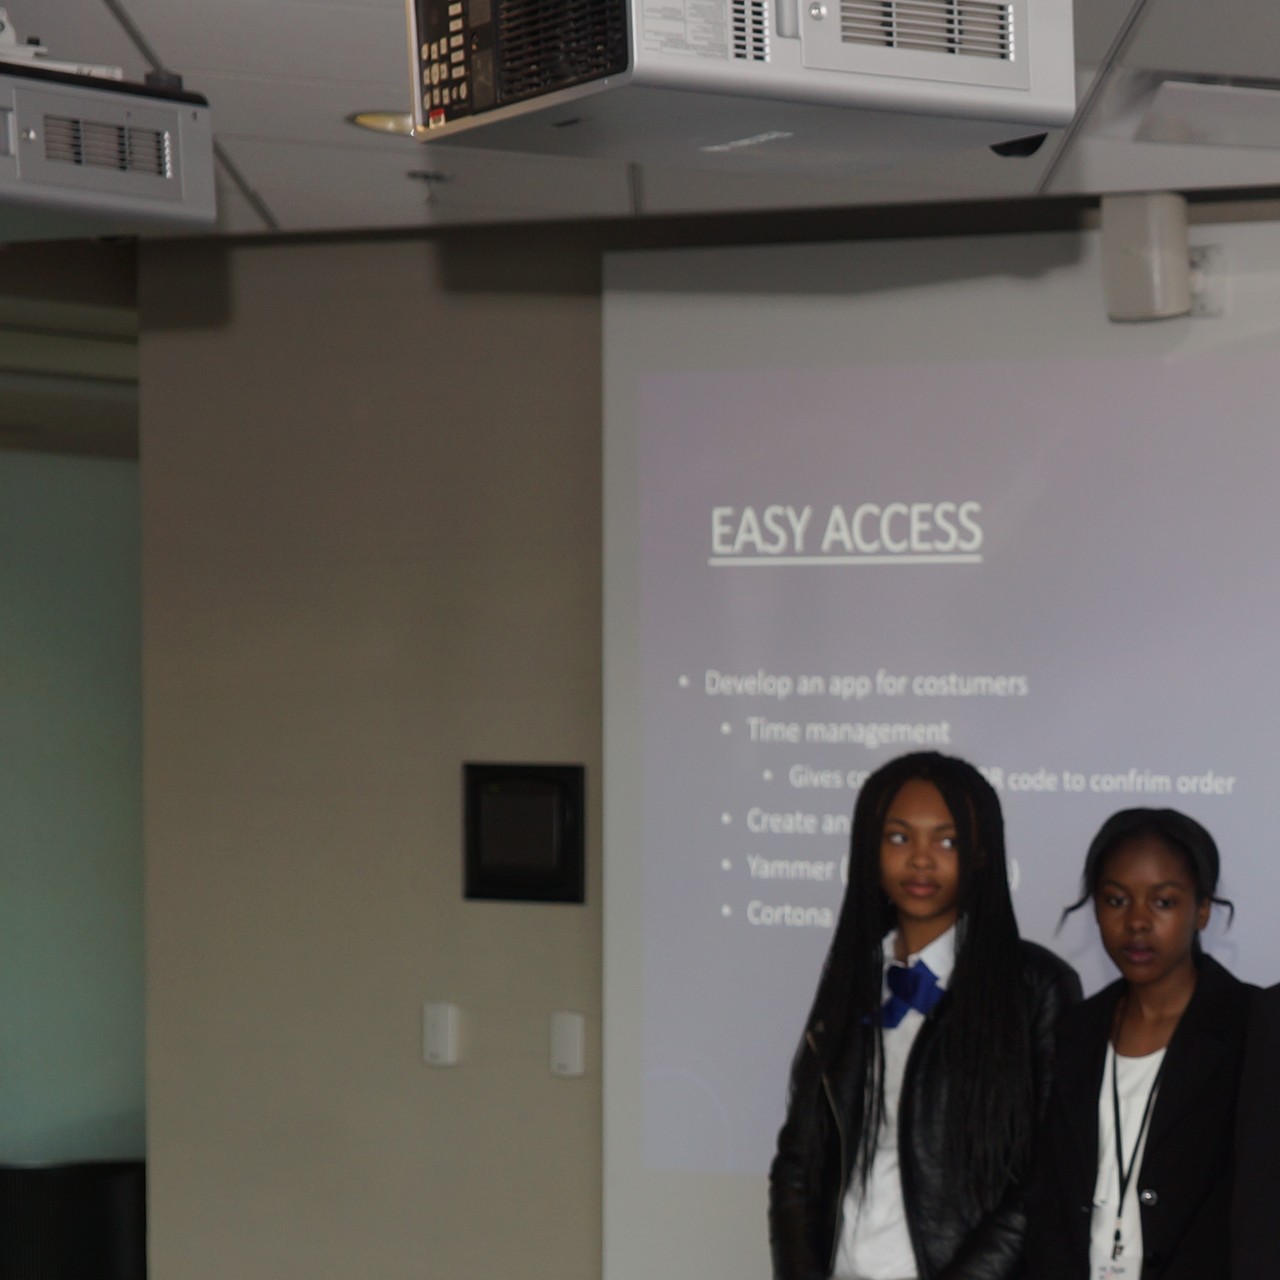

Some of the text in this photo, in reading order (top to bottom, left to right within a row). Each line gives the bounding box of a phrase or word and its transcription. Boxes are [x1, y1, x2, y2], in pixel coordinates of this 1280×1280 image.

[712, 501, 984, 556] EASY ACCESS
[705, 668, 1029, 700] Develop an app for costumers
[747, 716, 951, 749] Time management
[788, 764, 844, 789] Gives
[1007, 768, 1059, 792] code
[1062, 771, 1086, 793] to
[1089, 767, 1172, 793] confrim
[1176, 770, 1236, 795] order
[746, 807, 850, 835] Create an
[746, 855, 836, 881] Yammer
[746, 899, 833, 928] Cortona
